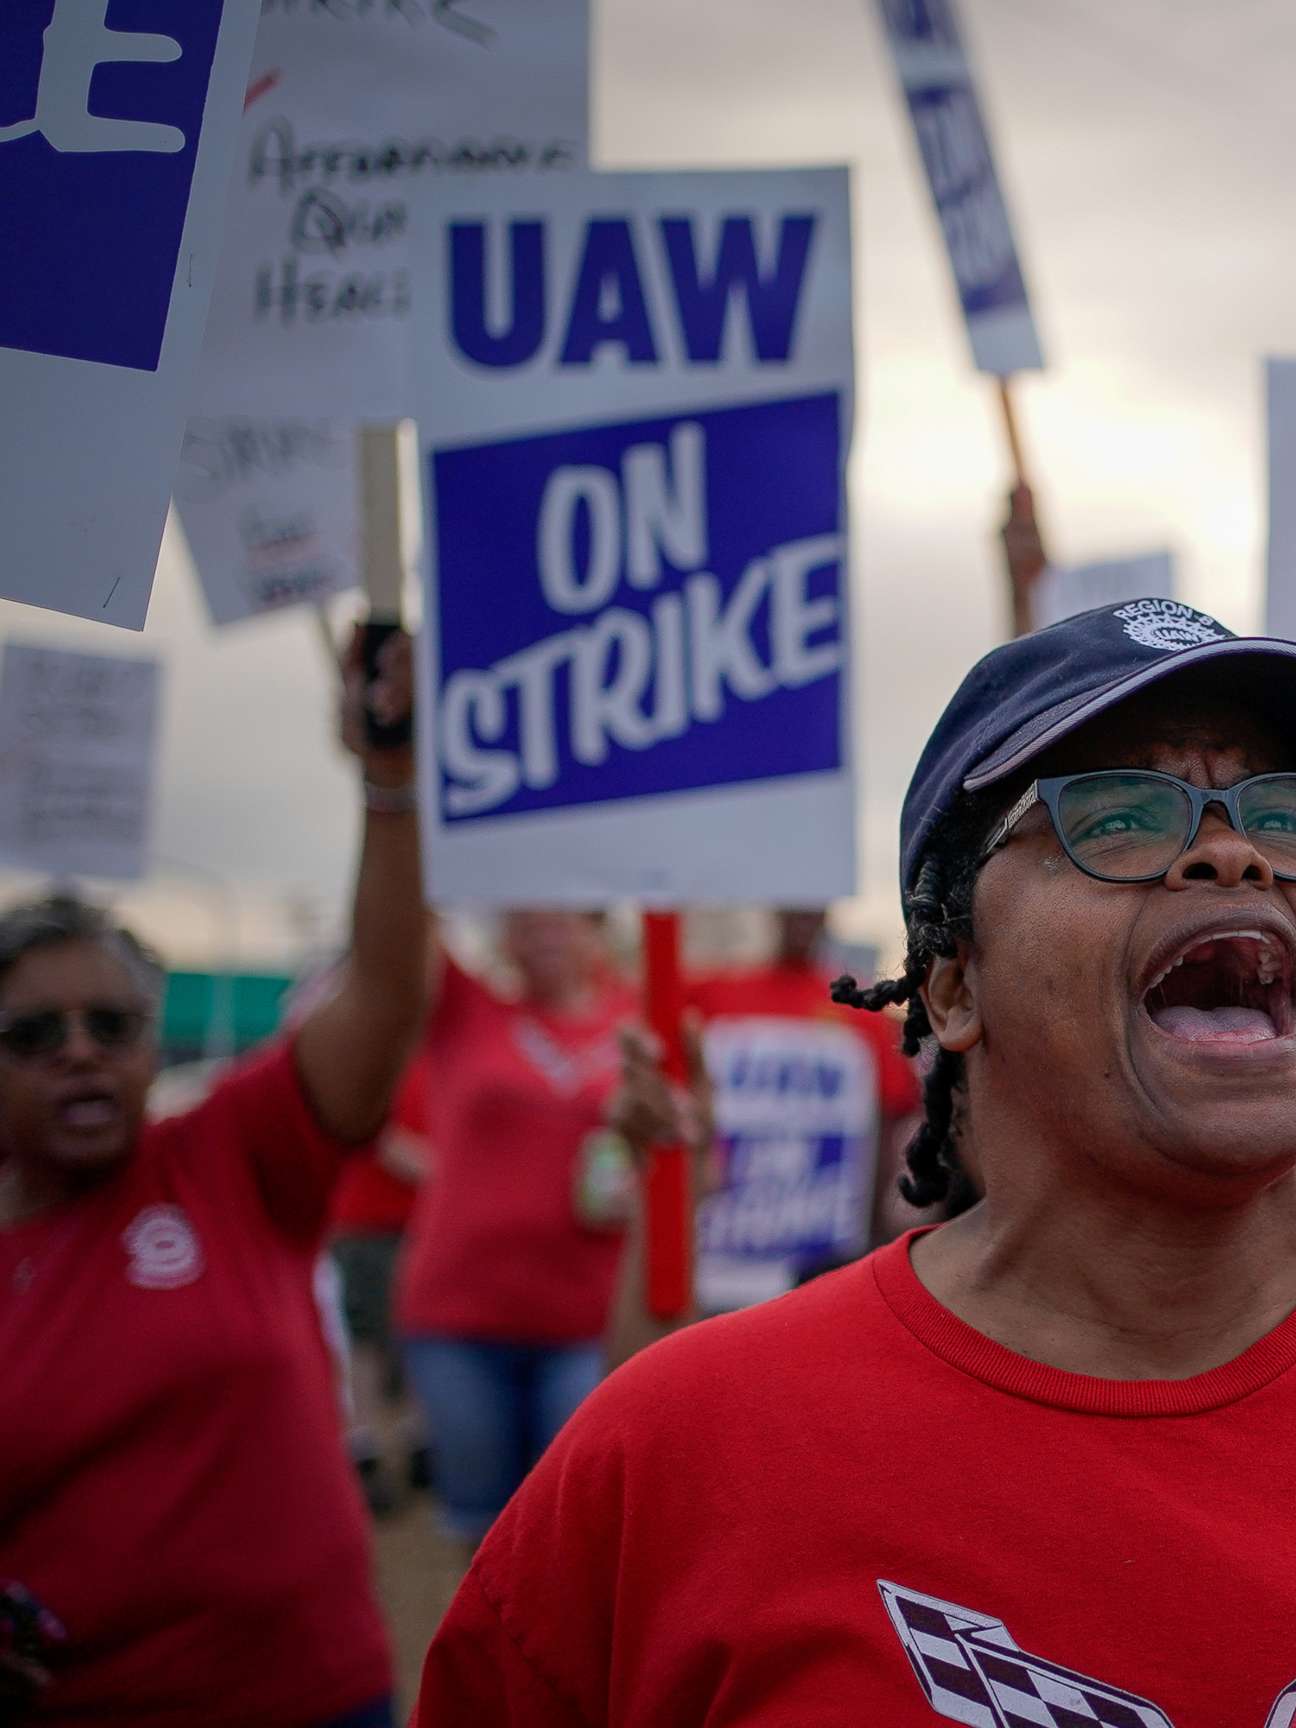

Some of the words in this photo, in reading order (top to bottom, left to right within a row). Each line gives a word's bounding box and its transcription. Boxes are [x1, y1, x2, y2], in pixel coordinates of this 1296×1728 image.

[449, 211, 815, 371] UAW
[538, 422, 707, 615] ON
[440, 533, 846, 819] STRIKE
[1157, 629, 1200, 642] UAW
